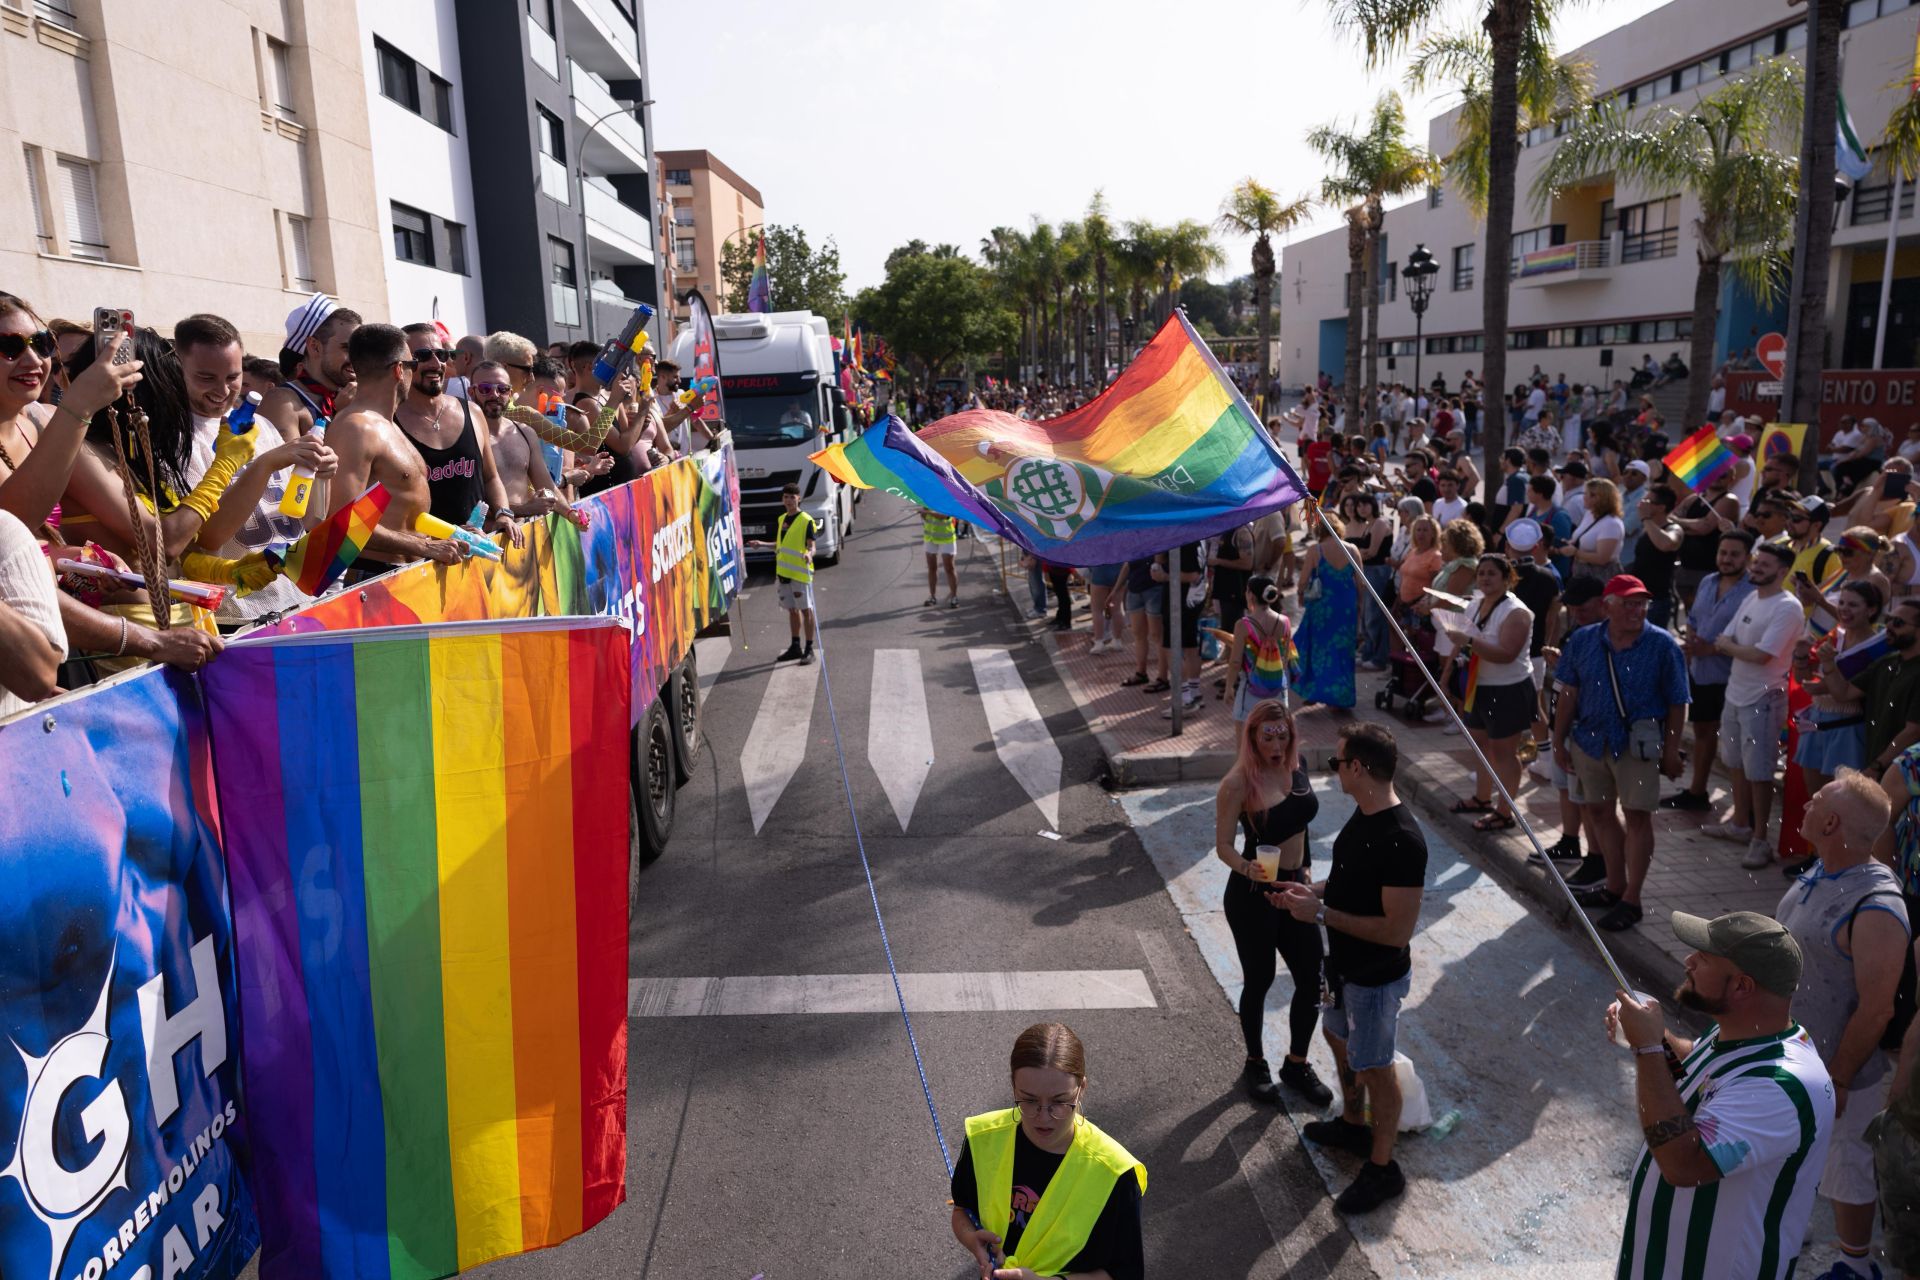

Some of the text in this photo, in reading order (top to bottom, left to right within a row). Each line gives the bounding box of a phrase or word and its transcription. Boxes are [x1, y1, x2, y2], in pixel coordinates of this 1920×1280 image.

[1886, 380, 1916, 405] DE
[73, 1100, 236, 1280] ORREMOLINOS
[130, 1183, 225, 1280] AR
